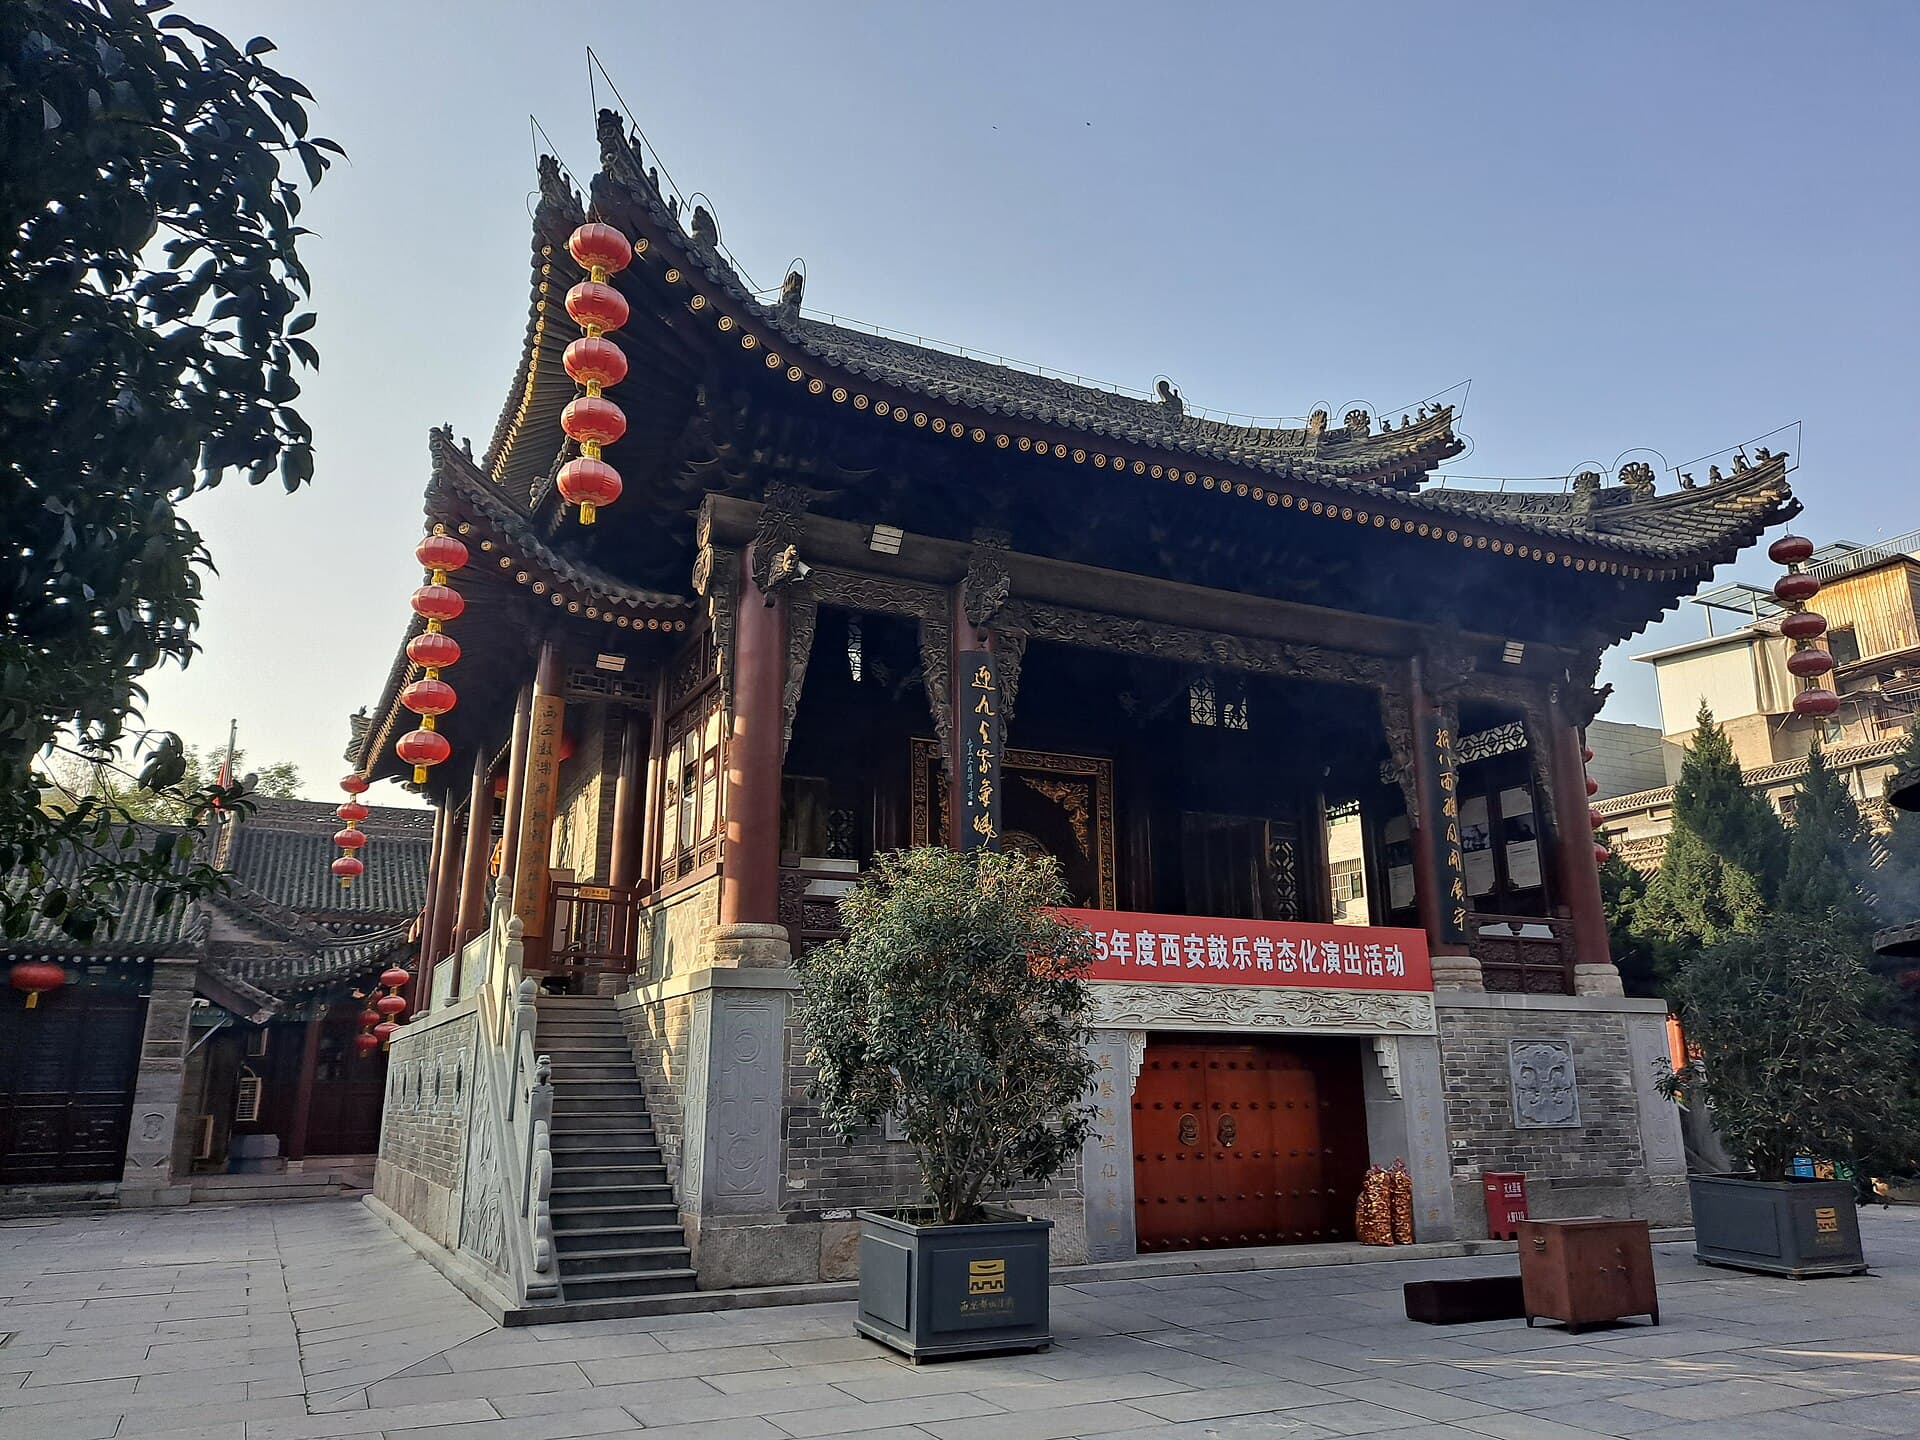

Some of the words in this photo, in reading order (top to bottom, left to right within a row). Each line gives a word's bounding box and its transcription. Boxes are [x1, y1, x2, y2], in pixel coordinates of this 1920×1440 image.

[1083, 929, 1405, 977] 5年度西安鼓乐常态化演出活动
